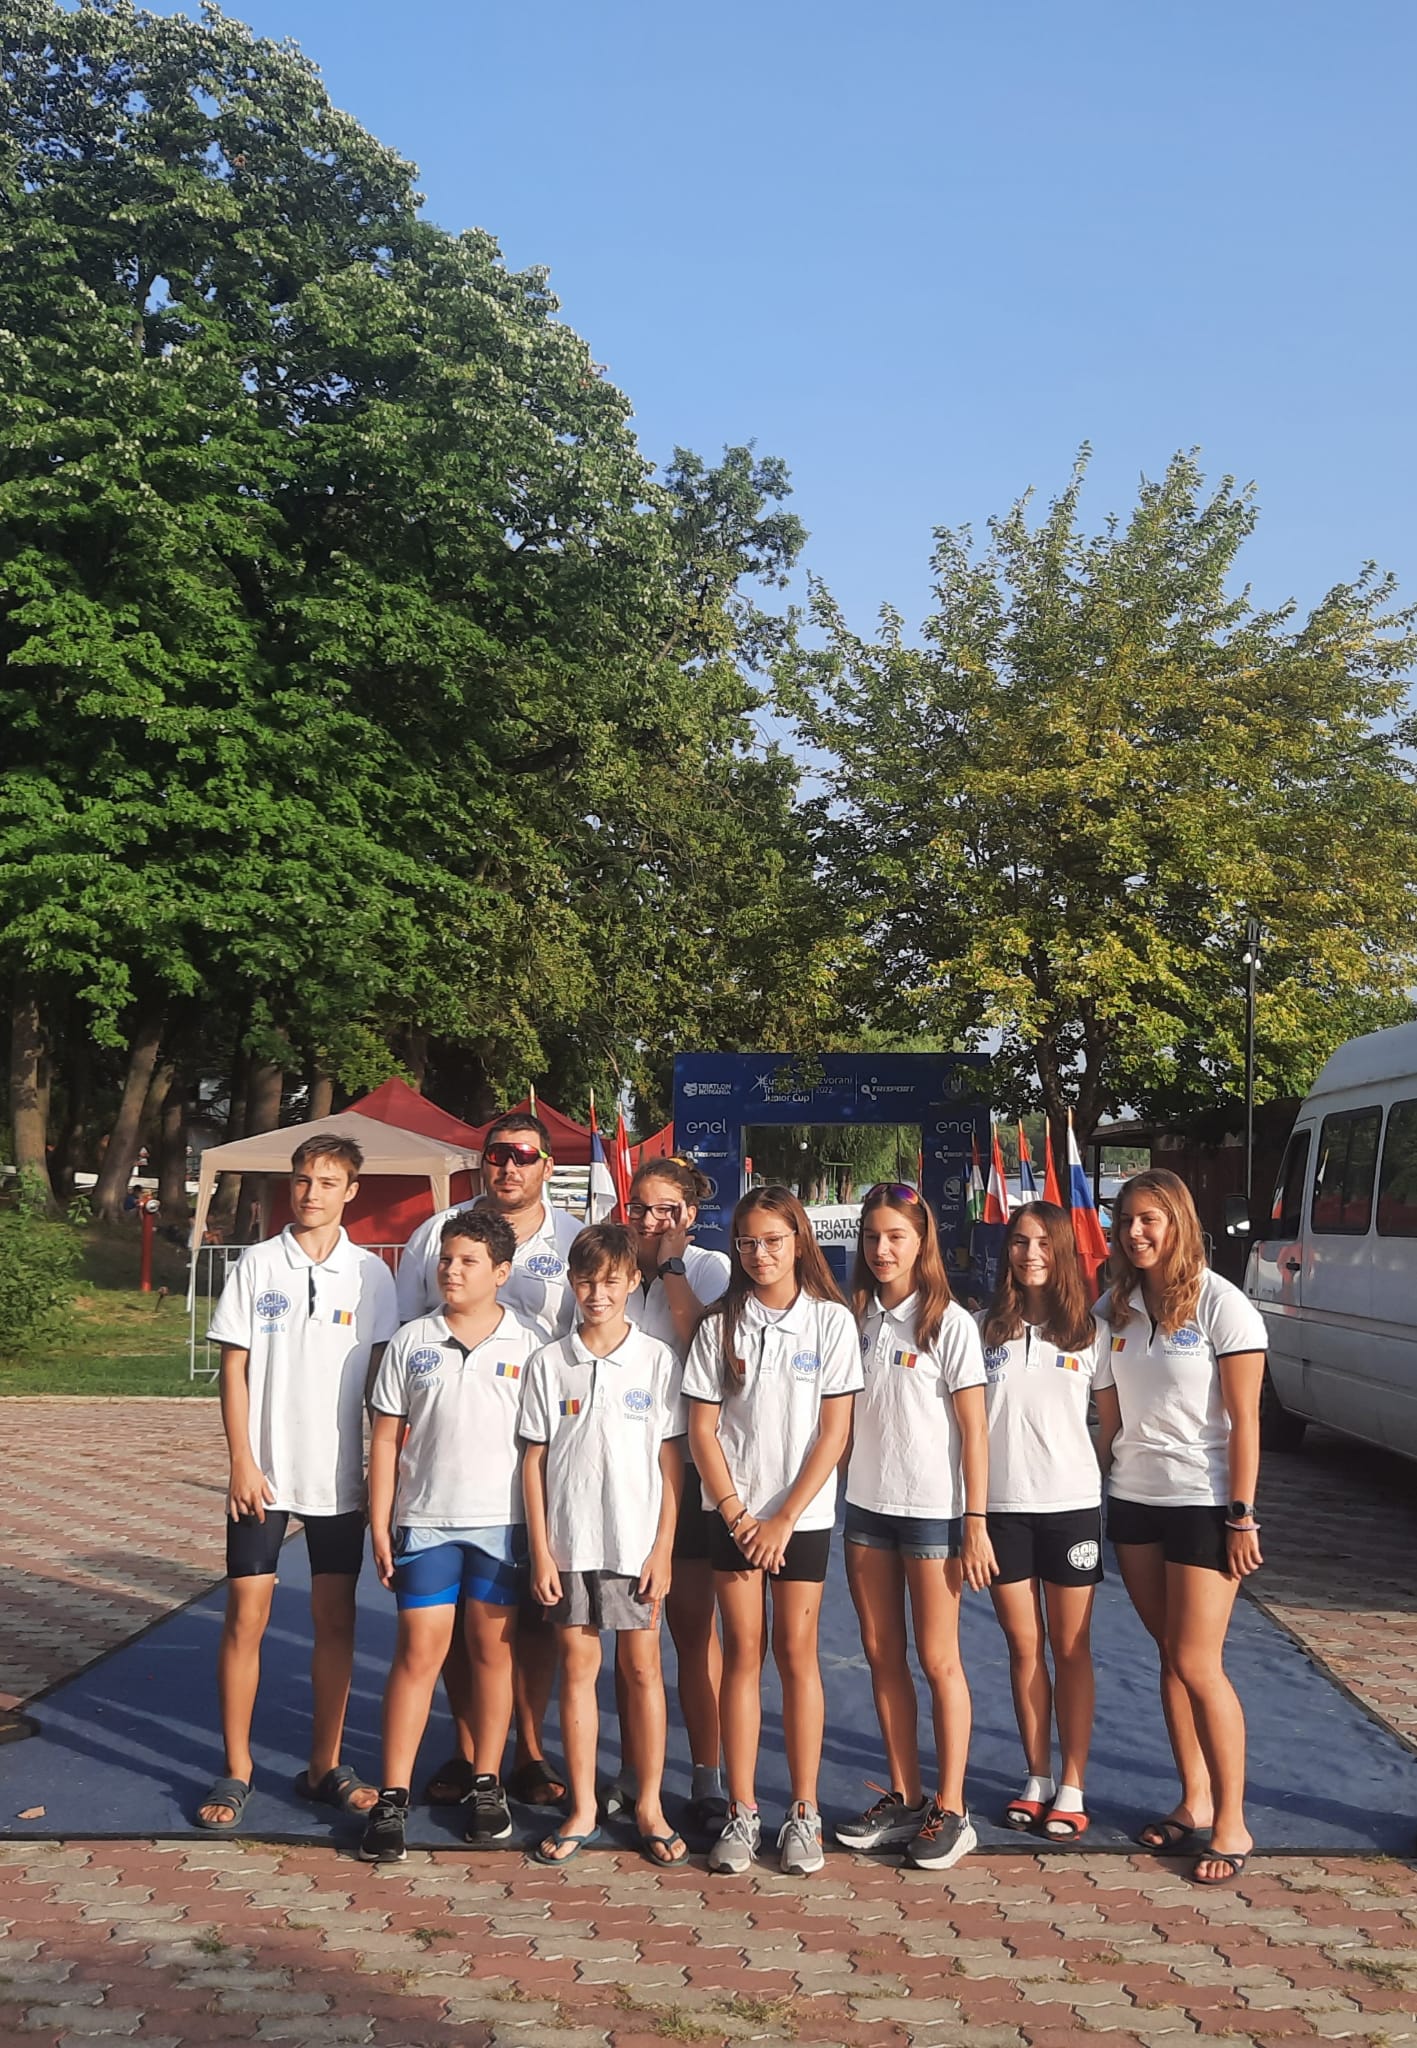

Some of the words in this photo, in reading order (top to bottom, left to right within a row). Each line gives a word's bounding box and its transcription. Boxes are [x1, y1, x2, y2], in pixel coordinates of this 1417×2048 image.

[792, 1093, 810, 1103] Cup
[686, 1118, 727, 1134] enel
[936, 1118, 977, 1134] enel
[812, 1217, 863, 1230] TRIATLO
[815, 1228, 860, 1241] ROMAN
